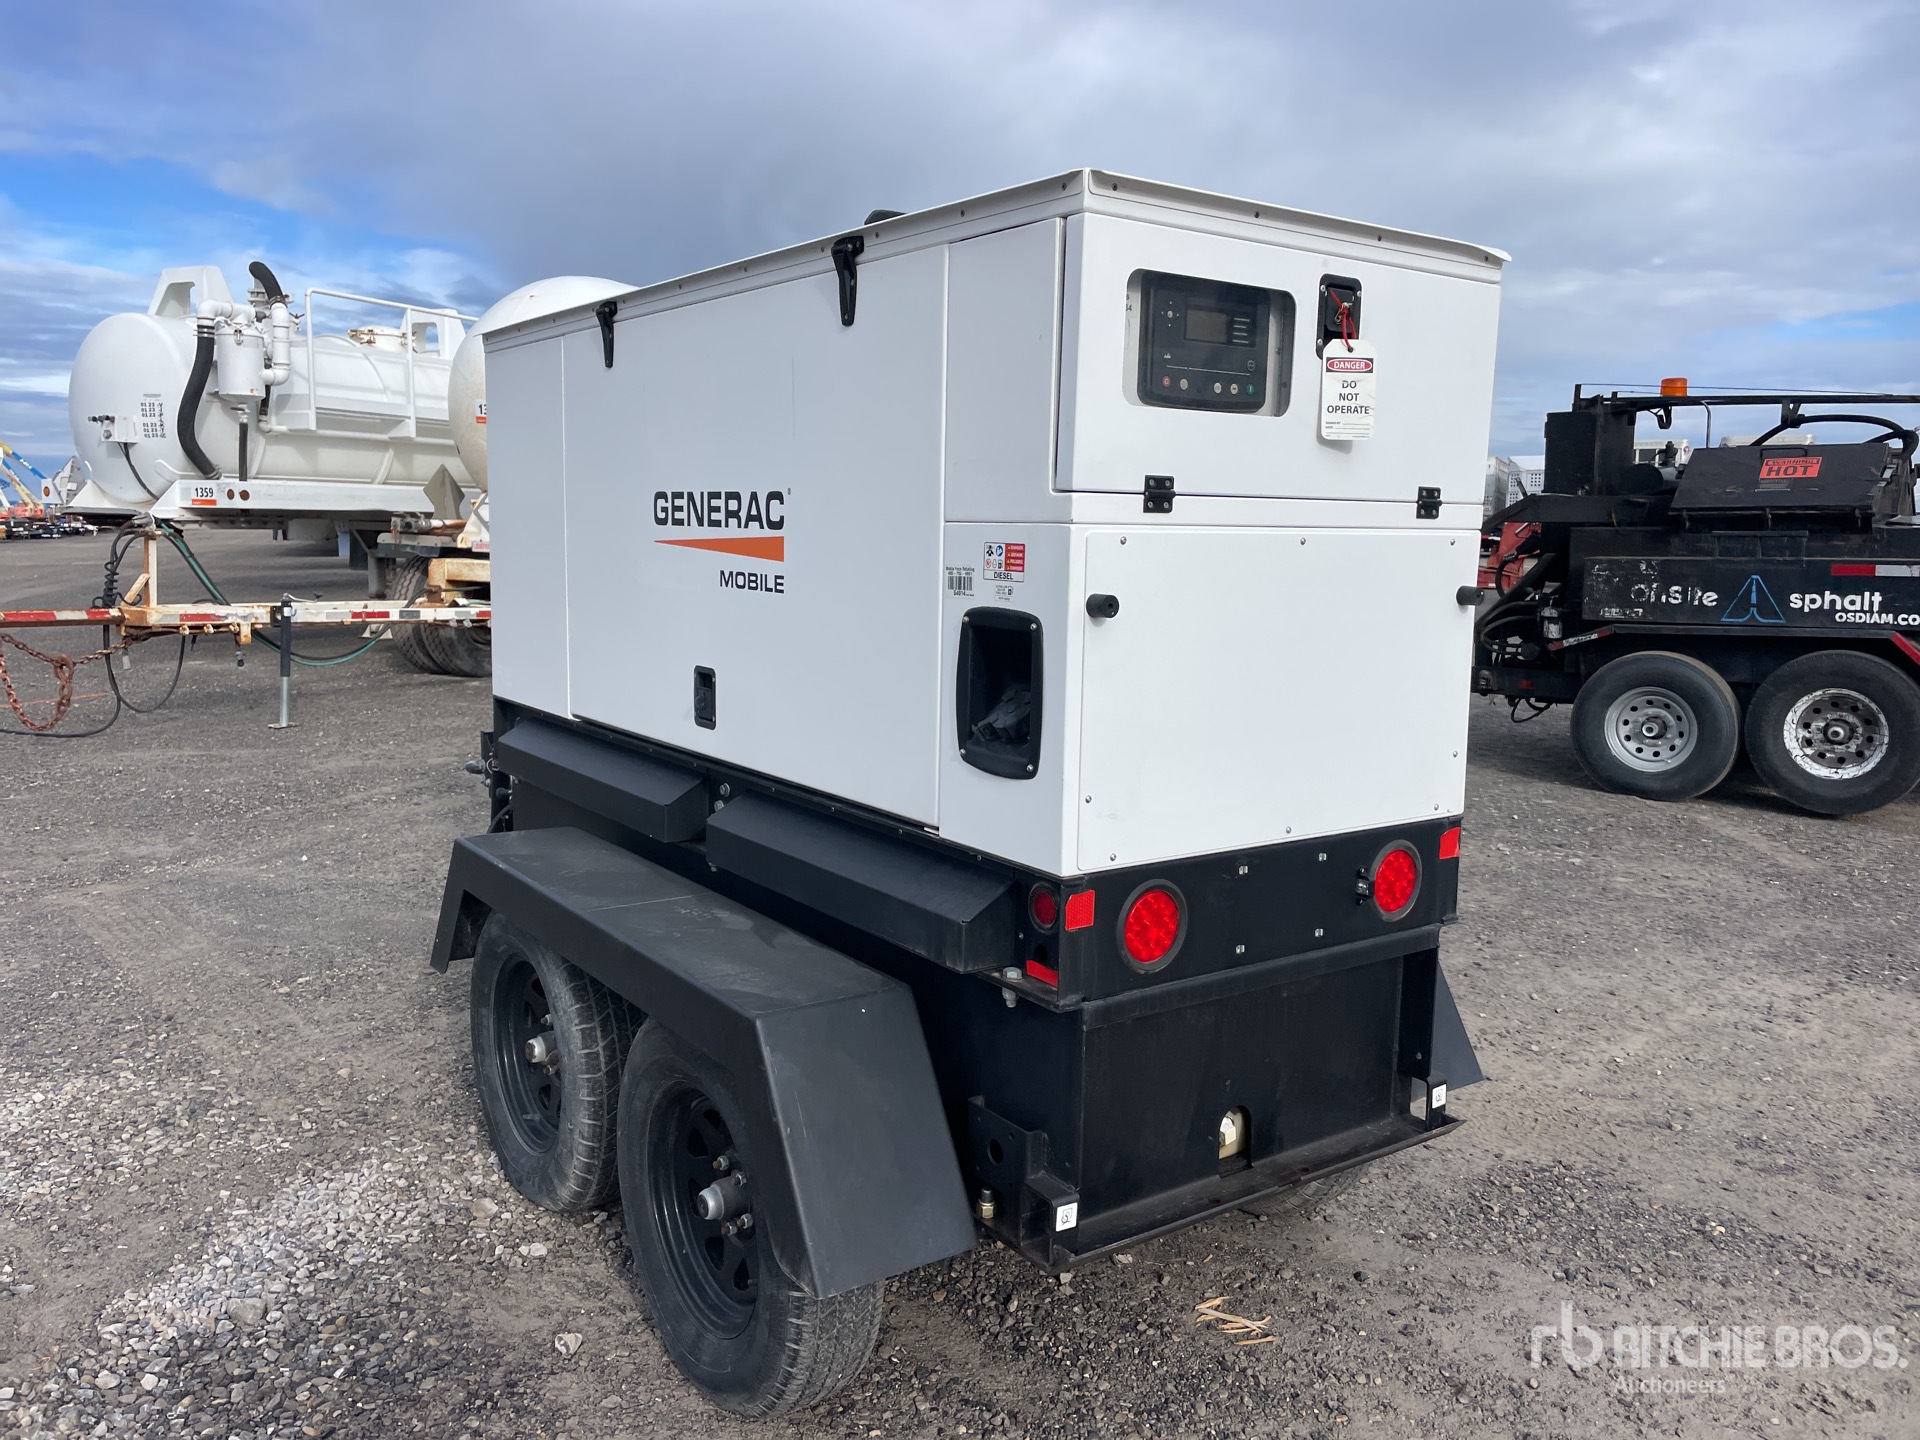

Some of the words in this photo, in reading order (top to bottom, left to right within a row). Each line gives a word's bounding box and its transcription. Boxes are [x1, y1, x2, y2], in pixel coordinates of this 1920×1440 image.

[1334, 361, 1366, 369] DANGER
[1342, 380, 1357, 389] DO
[1338, 393, 1360, 402] NOT
[1327, 405, 1370, 414] OPERATE
[1766, 465, 1813, 477] HOT
[195, 487, 214, 498] 1359
[653, 490, 785, 531] GENERAC
[993, 571, 1014, 580] DIESEL
[719, 569, 785, 594] MOBILE
[1835, 612, 1920, 626] OSDIAM.CO
